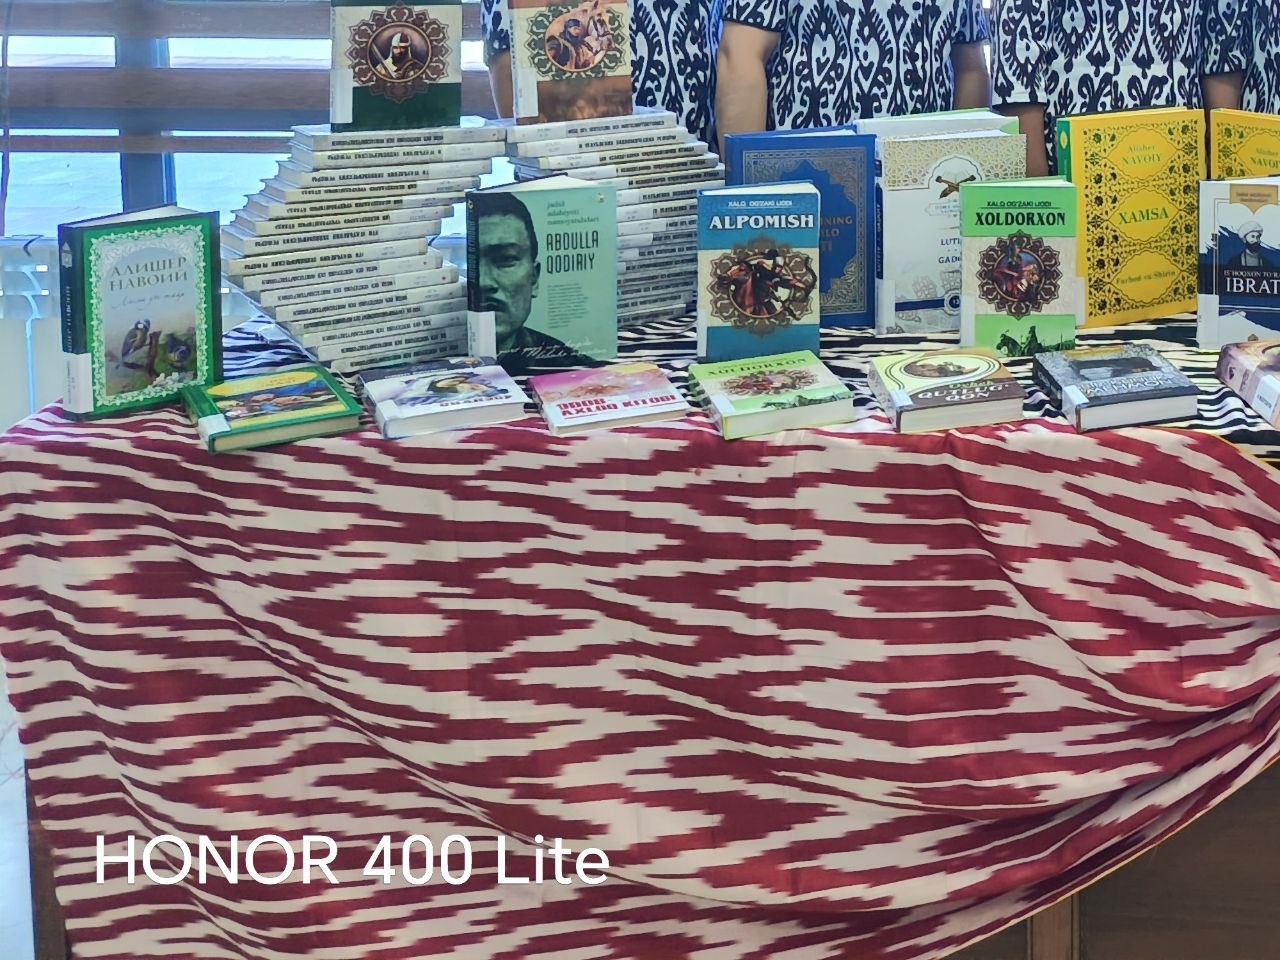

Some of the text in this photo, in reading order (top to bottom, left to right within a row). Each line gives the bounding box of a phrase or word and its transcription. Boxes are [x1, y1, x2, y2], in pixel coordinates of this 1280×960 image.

[1121, 153, 1163, 166] NAVOIY
[709, 214, 814, 230] ALPOMISH
[974, 212, 1066, 226] XOLDORXON
[1118, 207, 1169, 225] XAMSA
[546, 230, 599, 252] ABDULLA
[111, 256, 187, 277] АЛИШЕР
[546, 253, 595, 275] QODIRIY
[622, 394, 677, 408] KITOBI
[945, 390, 990, 402] QON
